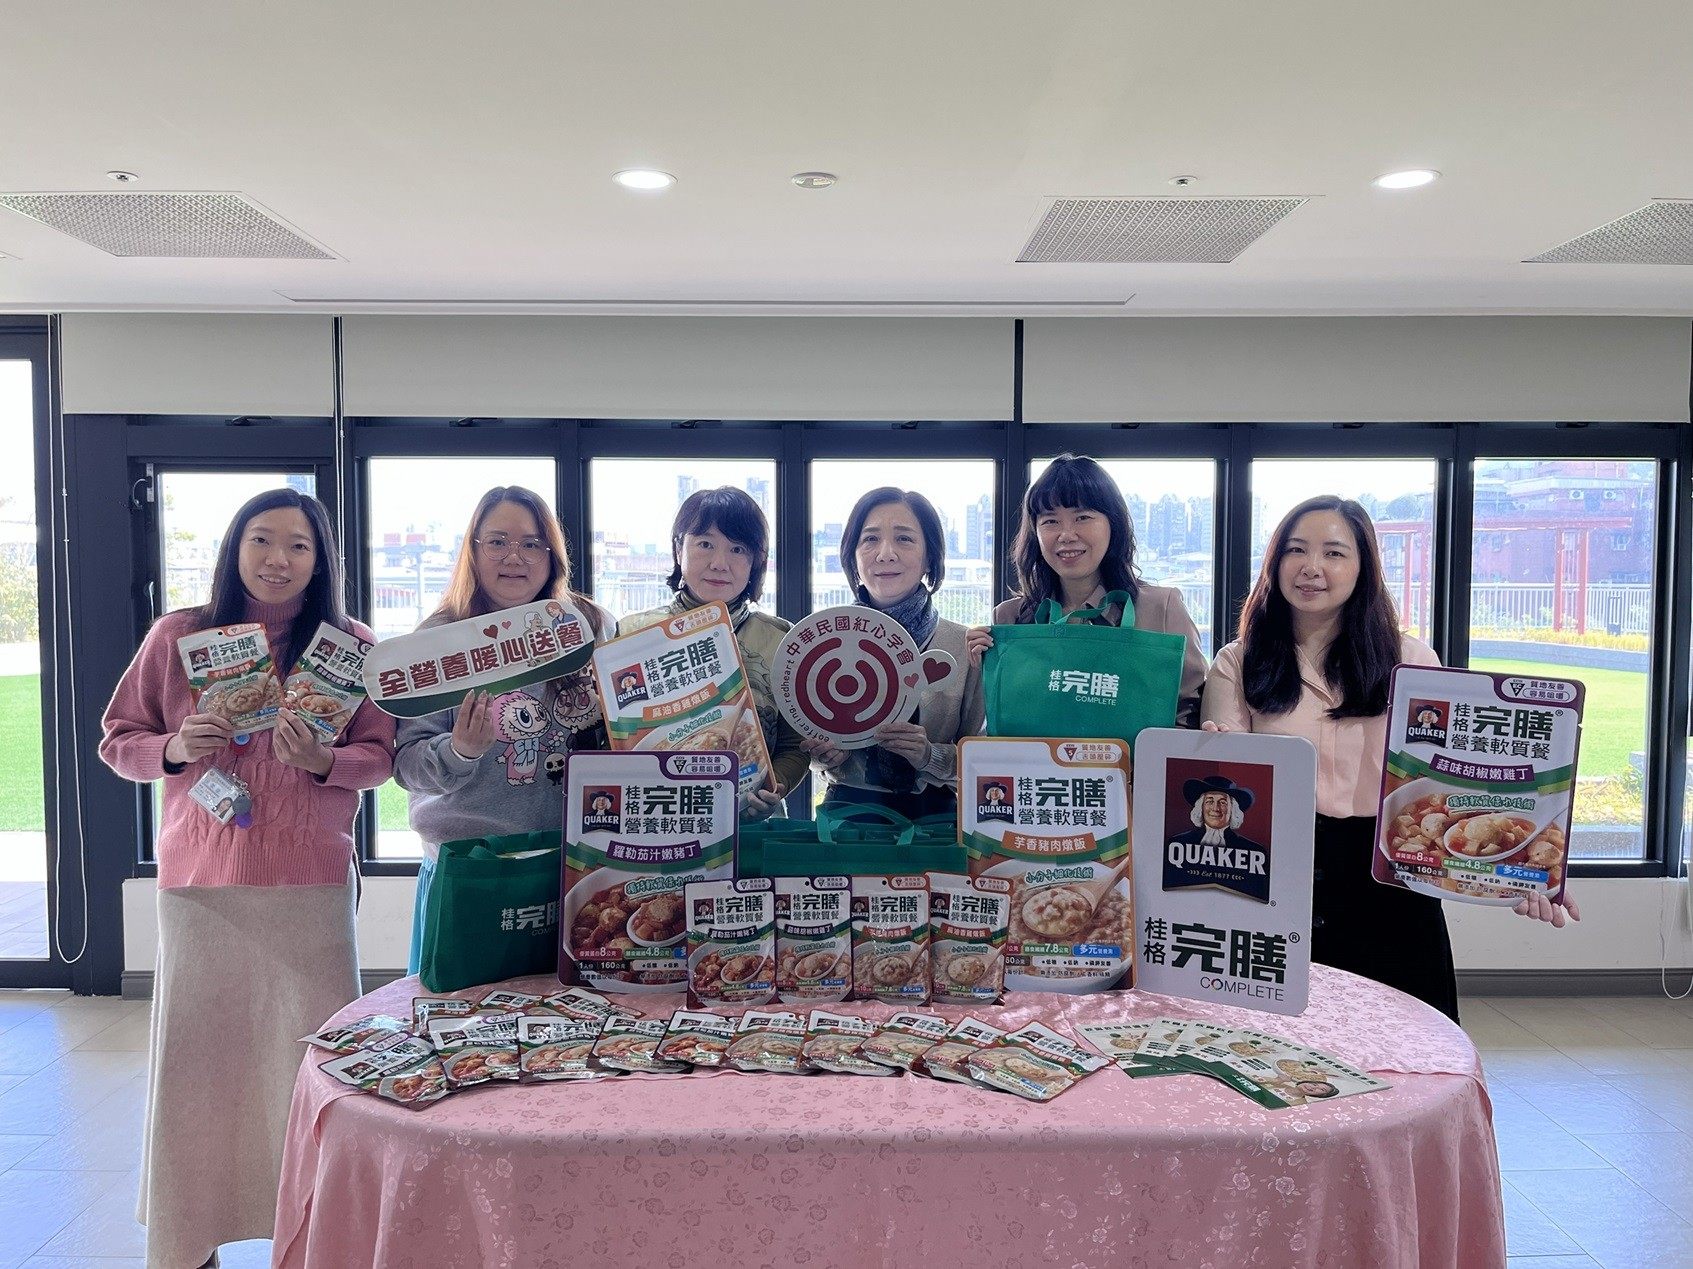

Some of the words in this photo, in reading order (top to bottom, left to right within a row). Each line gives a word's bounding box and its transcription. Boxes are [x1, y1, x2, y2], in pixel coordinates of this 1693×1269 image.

[219, 635, 258, 656] 完膳
[786, 615, 915, 665] 中華民國紅心字會
[378, 622, 584, 698] 全營養暖心送餐
[658, 636, 718, 678] 完膳
[644, 658, 660, 683] 桂格
[650, 660, 723, 698] 營養軟質餐
[1048, 669, 1063, 692] 桂格
[617, 686, 646, 703] QUAKER
[1062, 670, 1120, 698] 完膳
[1075, 695, 1117, 706] COMPLETE
[1453, 703, 1471, 732] 桂格
[1472, 706, 1553, 741] 完膳
[1408, 726, 1446, 739] QUAKER
[1451, 734, 1550, 760] 營養軟質餐
[1436, 758, 1529, 780] 蒜味胡椒嫩雞丁
[625, 785, 641, 815] 桂格
[643, 785, 714, 815] 完膳
[1018, 777, 1033, 806] 桂格
[1035, 777, 1106, 808] 完膳
[584, 815, 620, 825] QUAKER
[978, 805, 1013, 815] QUAKER
[1018, 808, 1107, 827] 營養軟質餐
[625, 817, 714, 835] 營養軟質餐
[613, 845, 696, 861] 羅勒茄汁嫩豬丁
[1015, 836, 1087, 851] 芋香豬肉燉飯
[1168, 842, 1267, 876] QUAKER
[725, 895, 763, 913] 完膳
[802, 893, 839, 910] 完膳
[881, 896, 917, 912] 完膳
[961, 896, 999, 915] 完膳
[501, 908, 515, 931] 桂格
[1143, 917, 1168, 966] 桂格
[1172, 922, 1288, 984] 完膳
[1200, 976, 1285, 1002] COMPLETE
